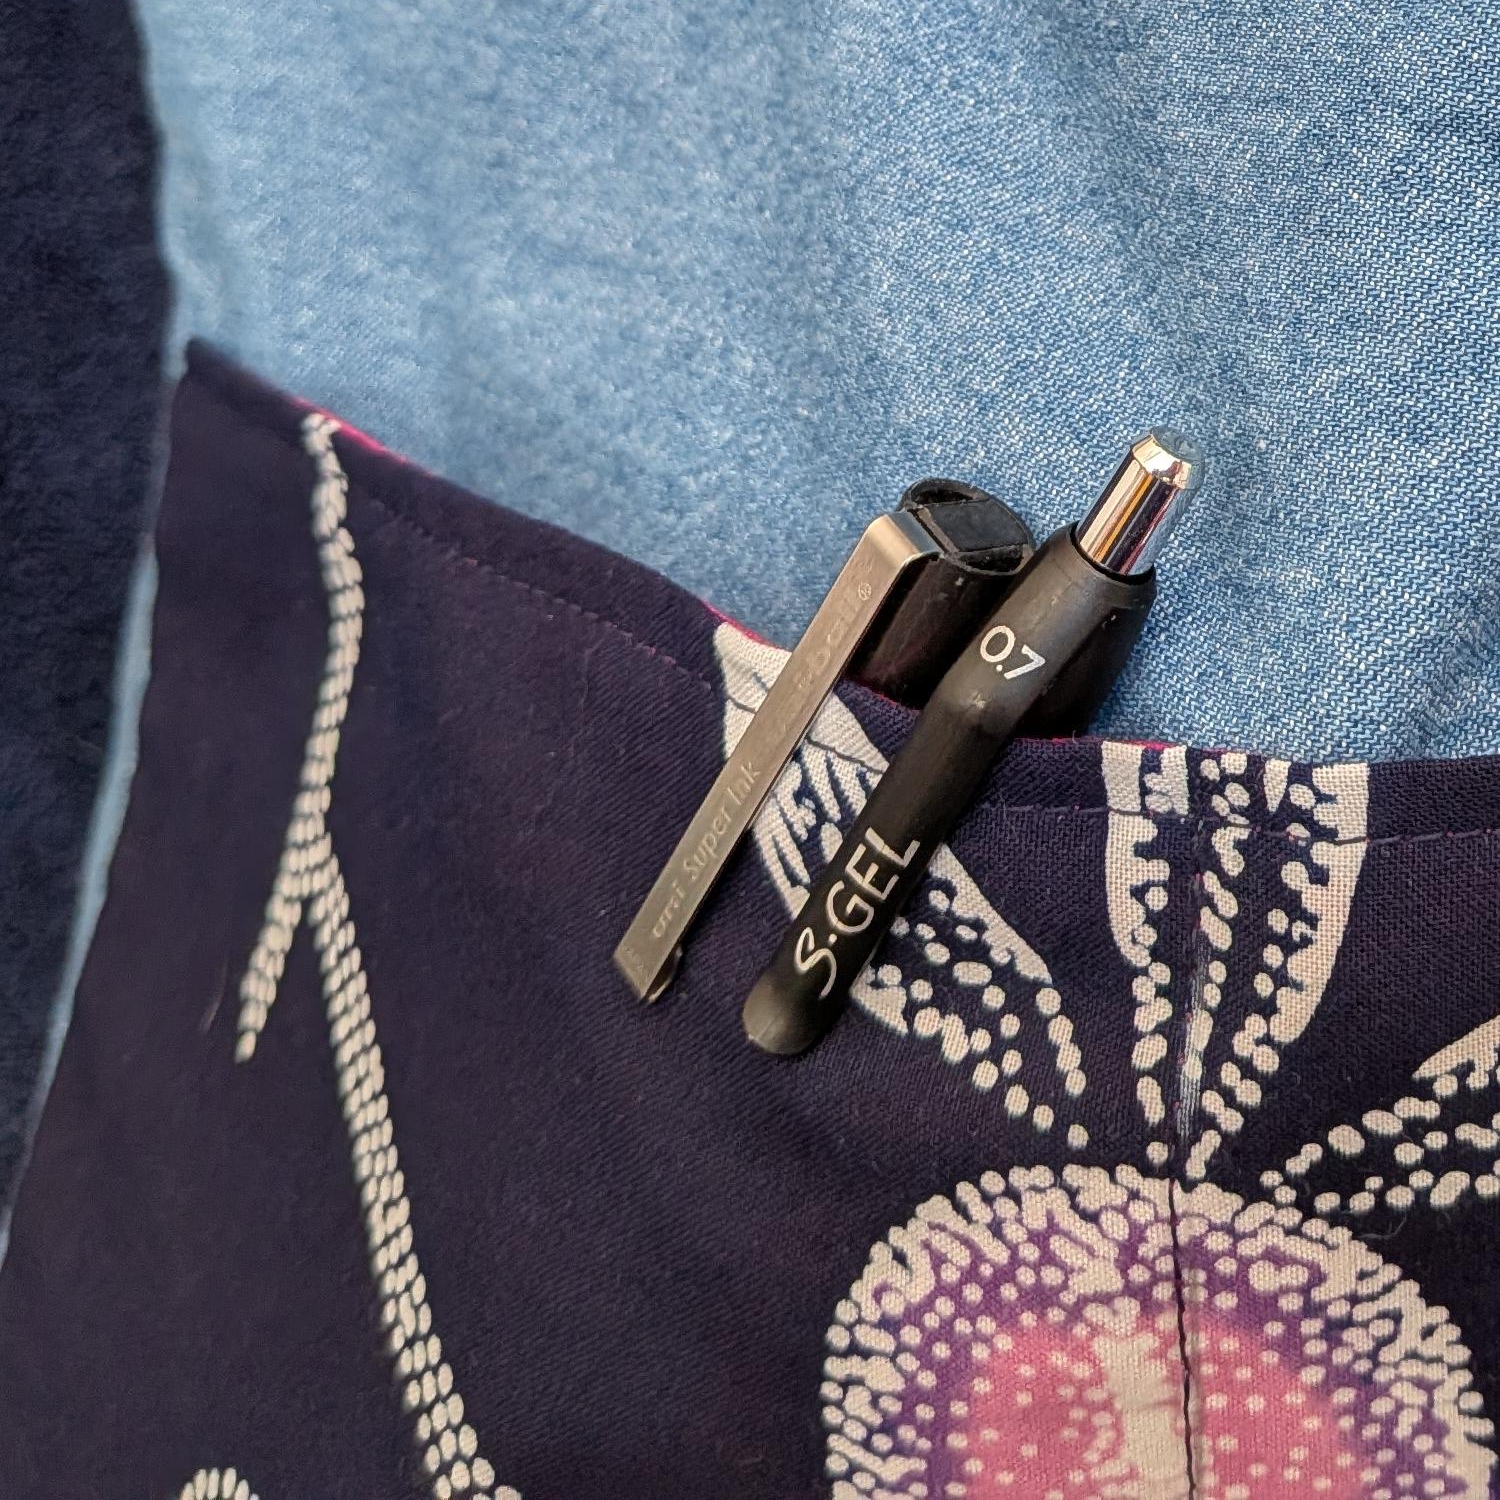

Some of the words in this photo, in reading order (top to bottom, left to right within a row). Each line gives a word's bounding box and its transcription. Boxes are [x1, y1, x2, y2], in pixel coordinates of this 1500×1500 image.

[980, 625, 1046, 680] 0.7
[683, 805, 732, 882] Super
[727, 762, 762, 805] Ink
[795, 826, 921, 1000] S.GEL
